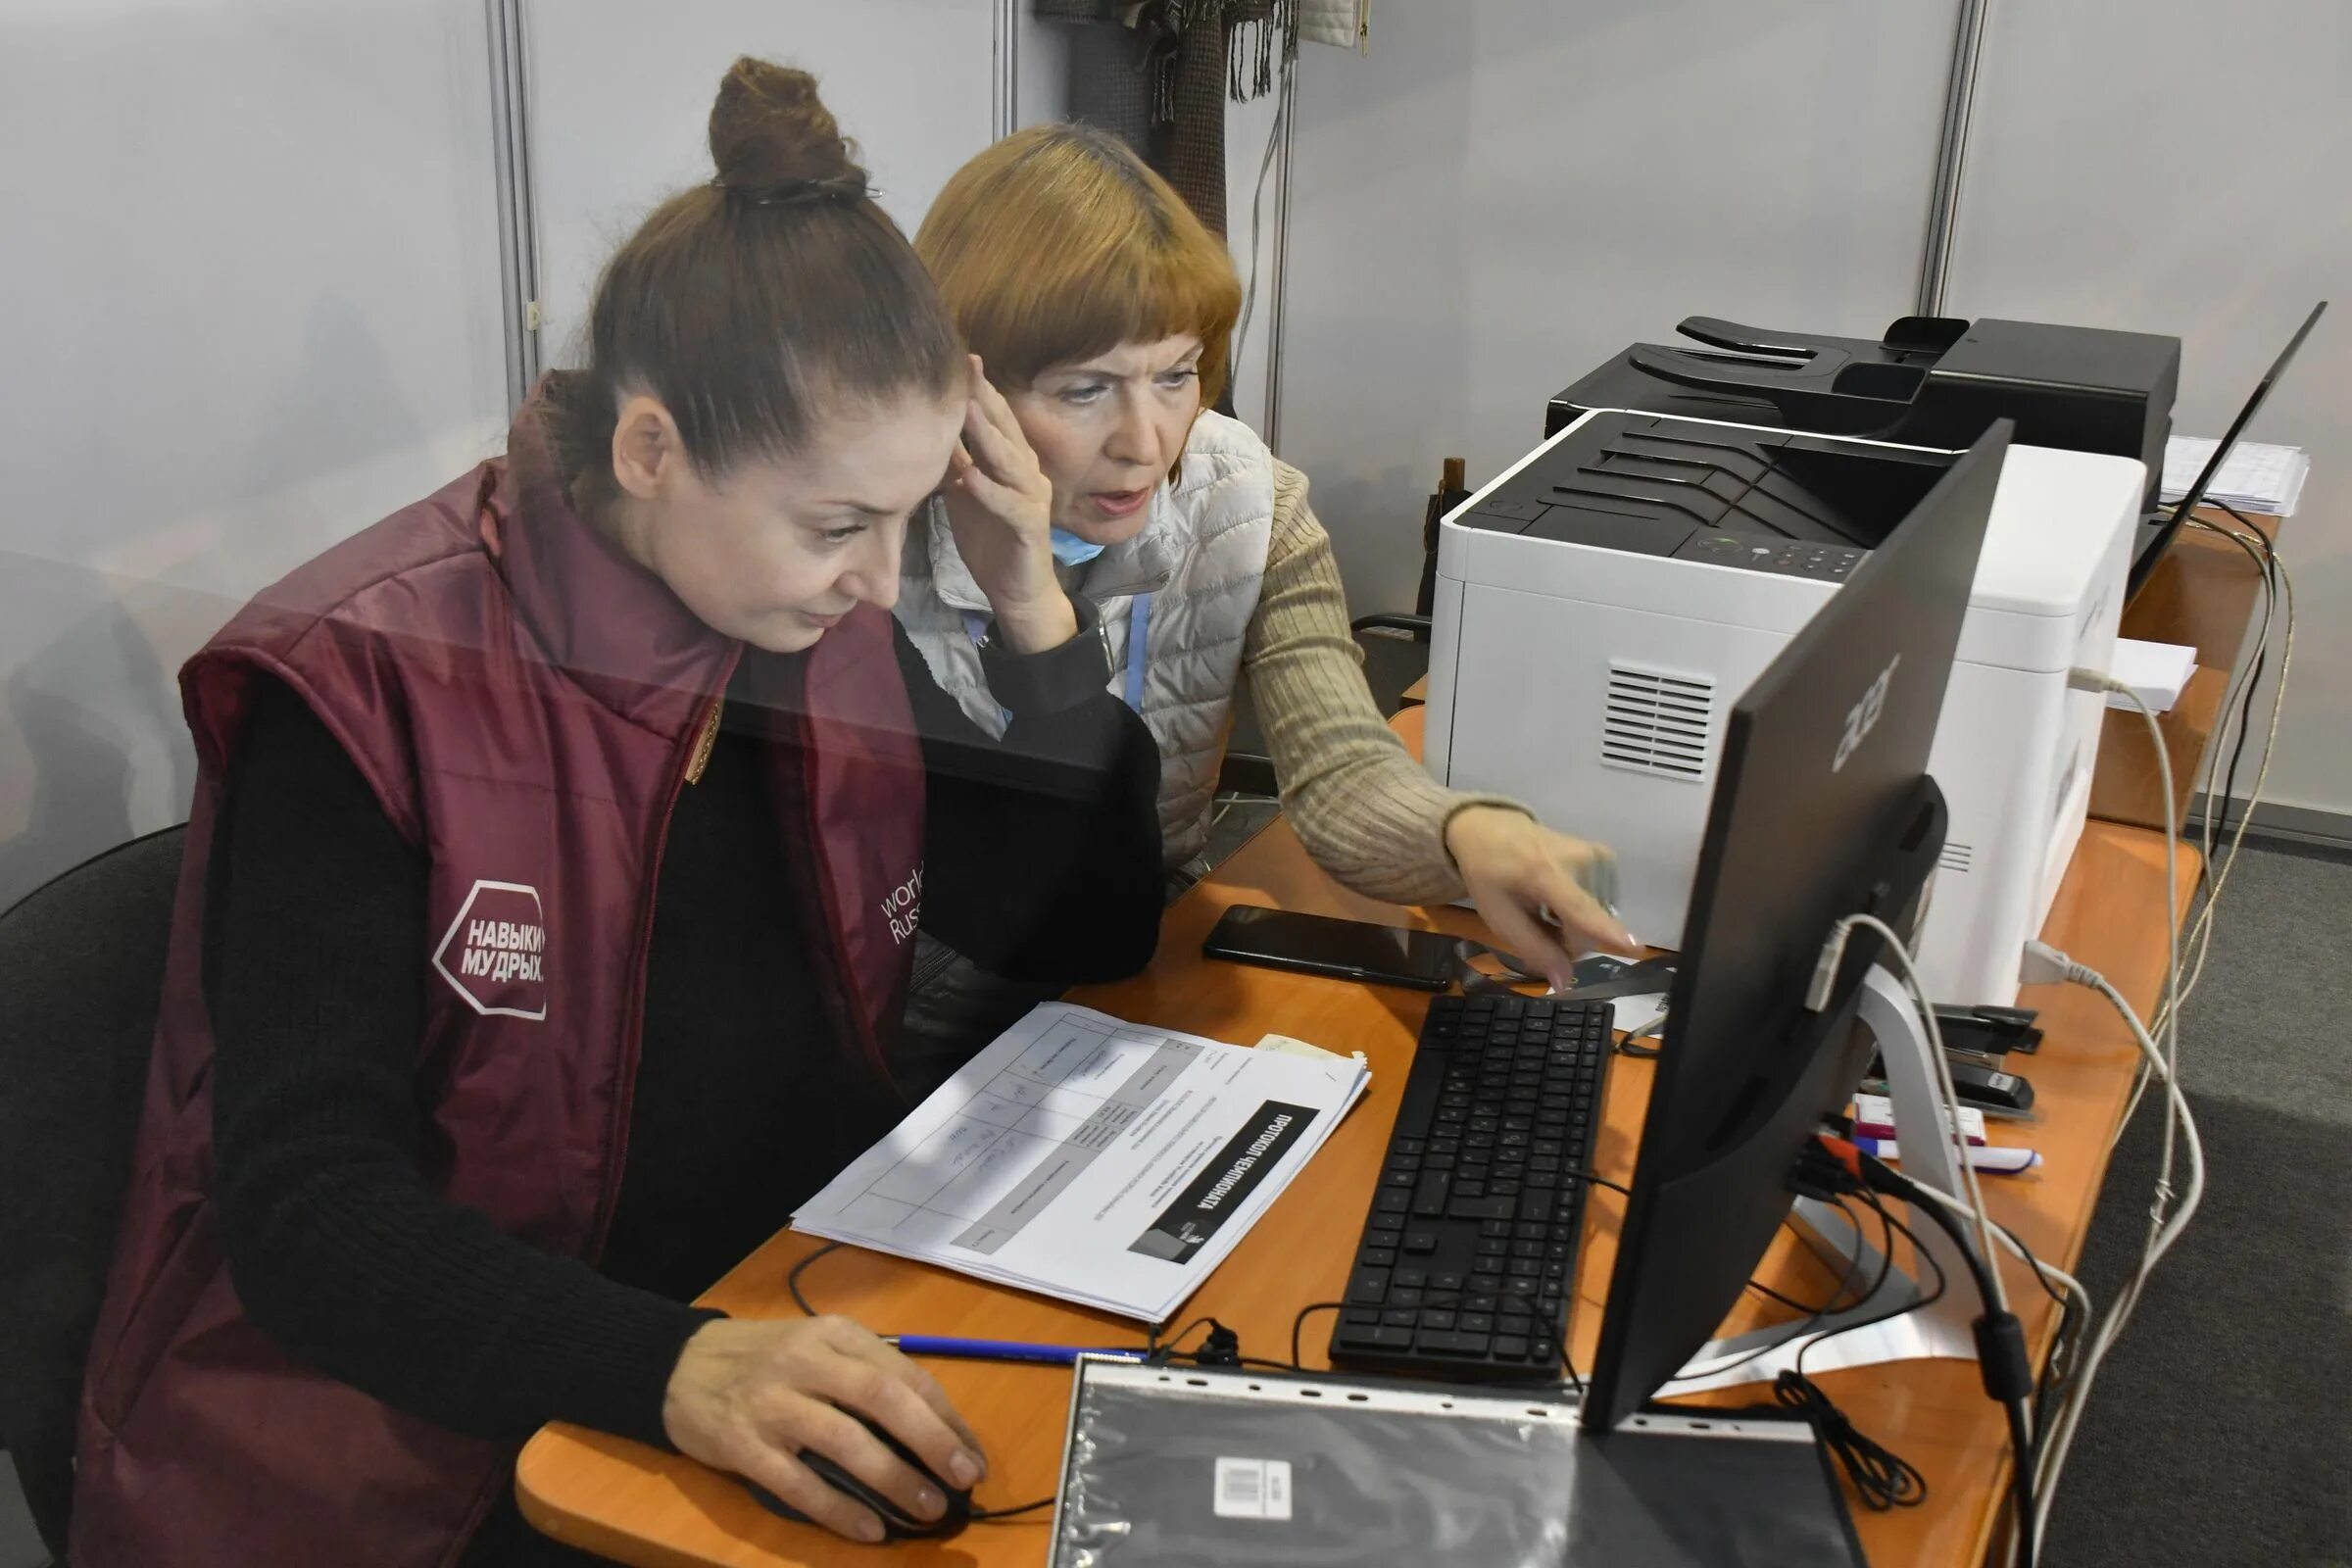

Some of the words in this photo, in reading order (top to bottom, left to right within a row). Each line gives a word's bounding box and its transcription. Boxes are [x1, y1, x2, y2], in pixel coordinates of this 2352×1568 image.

[1832, 652, 1902, 772] acer
[466, 919, 542, 953] НАВЫКИ
[461, 948, 543, 983] МУДРЫХ
[1246, 1113, 1294, 1157] ПРОТОКОЛ
[1197, 1155, 1257, 1210] ЧЕМПИОНАТА
